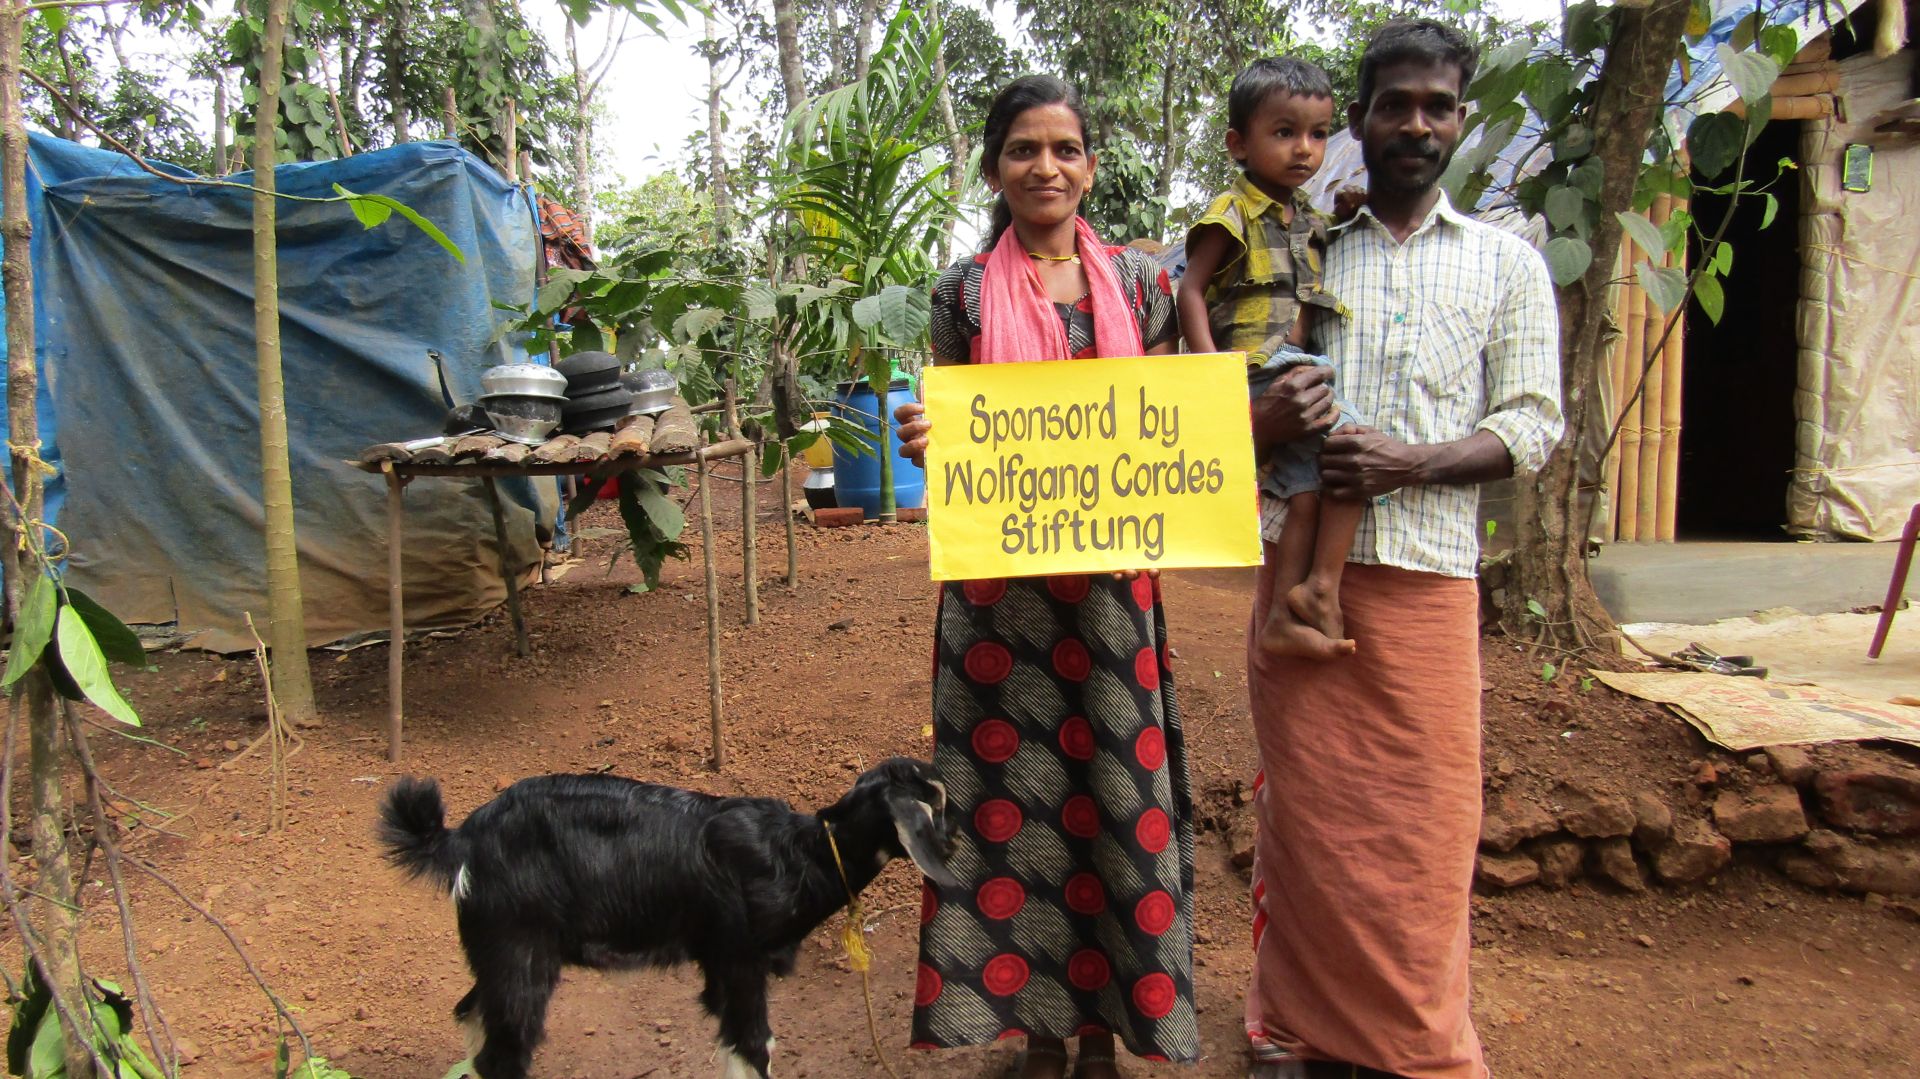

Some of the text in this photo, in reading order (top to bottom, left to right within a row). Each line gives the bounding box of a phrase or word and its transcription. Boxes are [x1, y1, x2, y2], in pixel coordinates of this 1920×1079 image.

[970, 384, 1180, 452] Sponsord by
[944, 449, 1224, 513] Wolfgang Cordes
[1001, 509, 1165, 561] Stiftung
